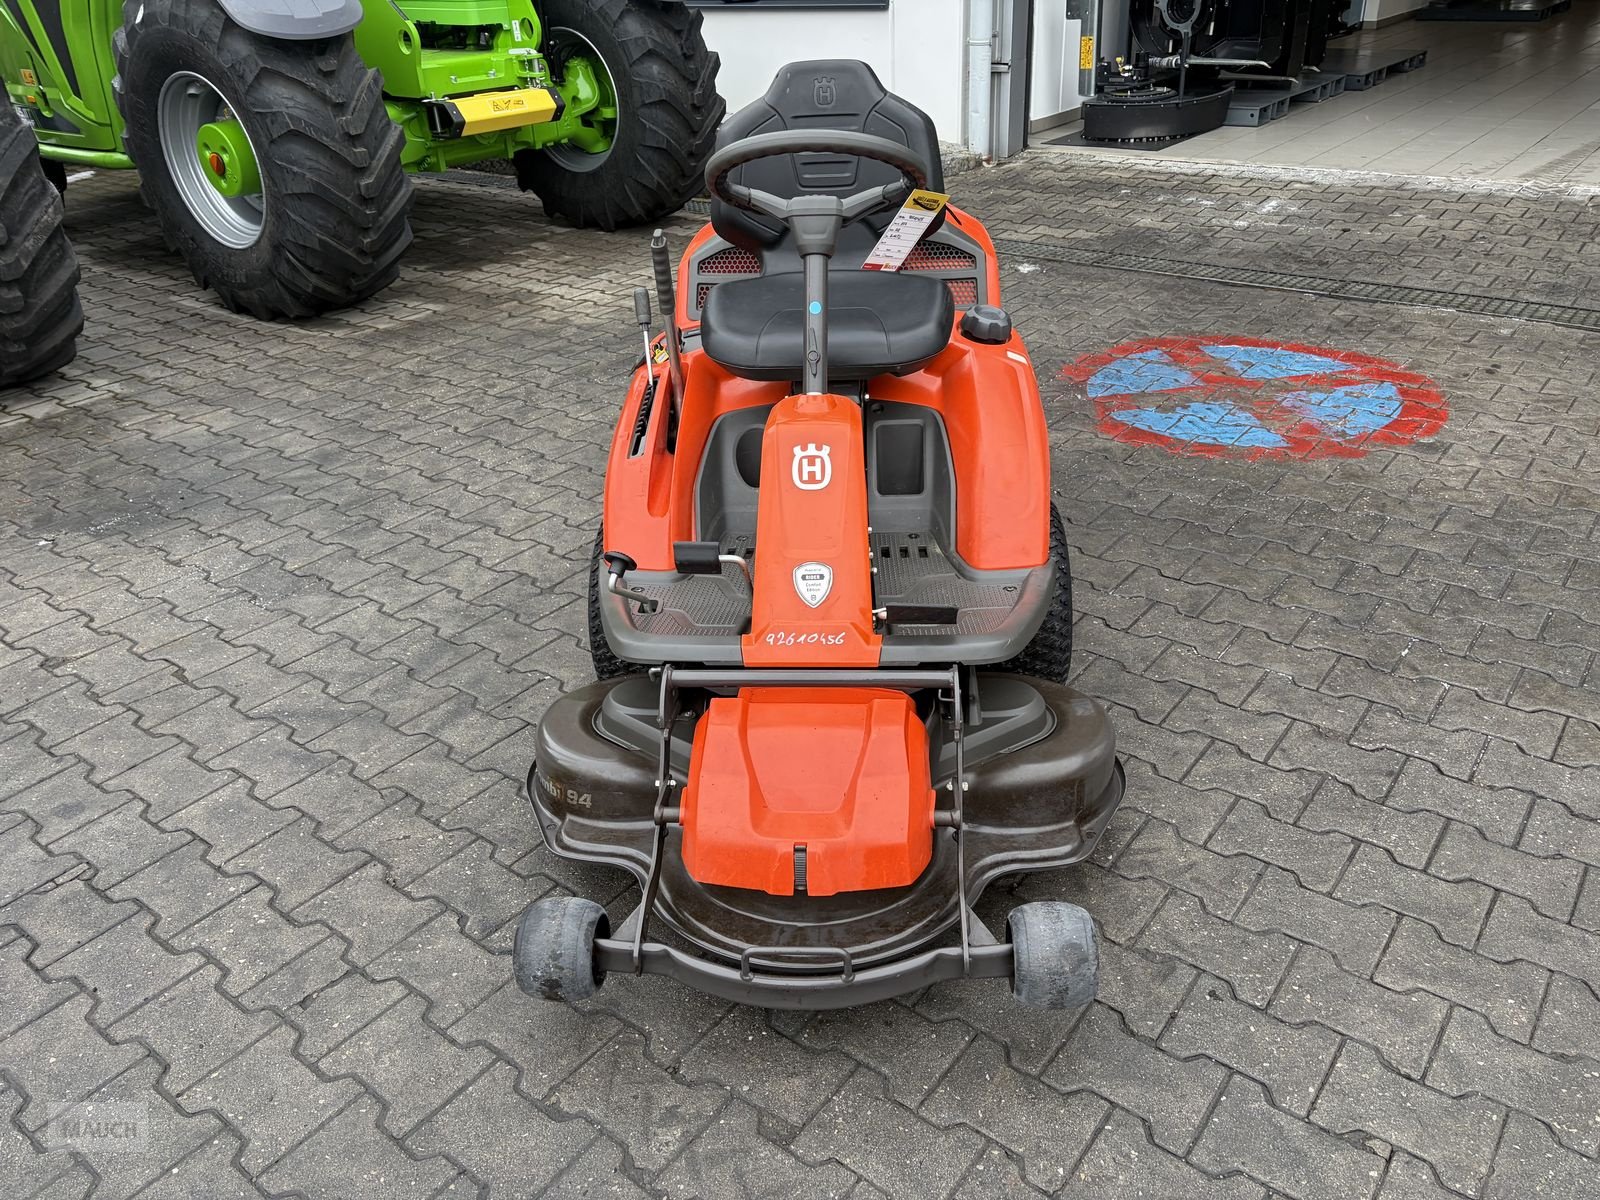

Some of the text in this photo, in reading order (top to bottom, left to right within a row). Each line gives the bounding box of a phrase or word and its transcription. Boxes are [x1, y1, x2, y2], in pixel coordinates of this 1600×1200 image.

[802, 458, 822, 481] H
[766, 631, 846, 646] 92610456
[566, 789, 592, 809] 94
